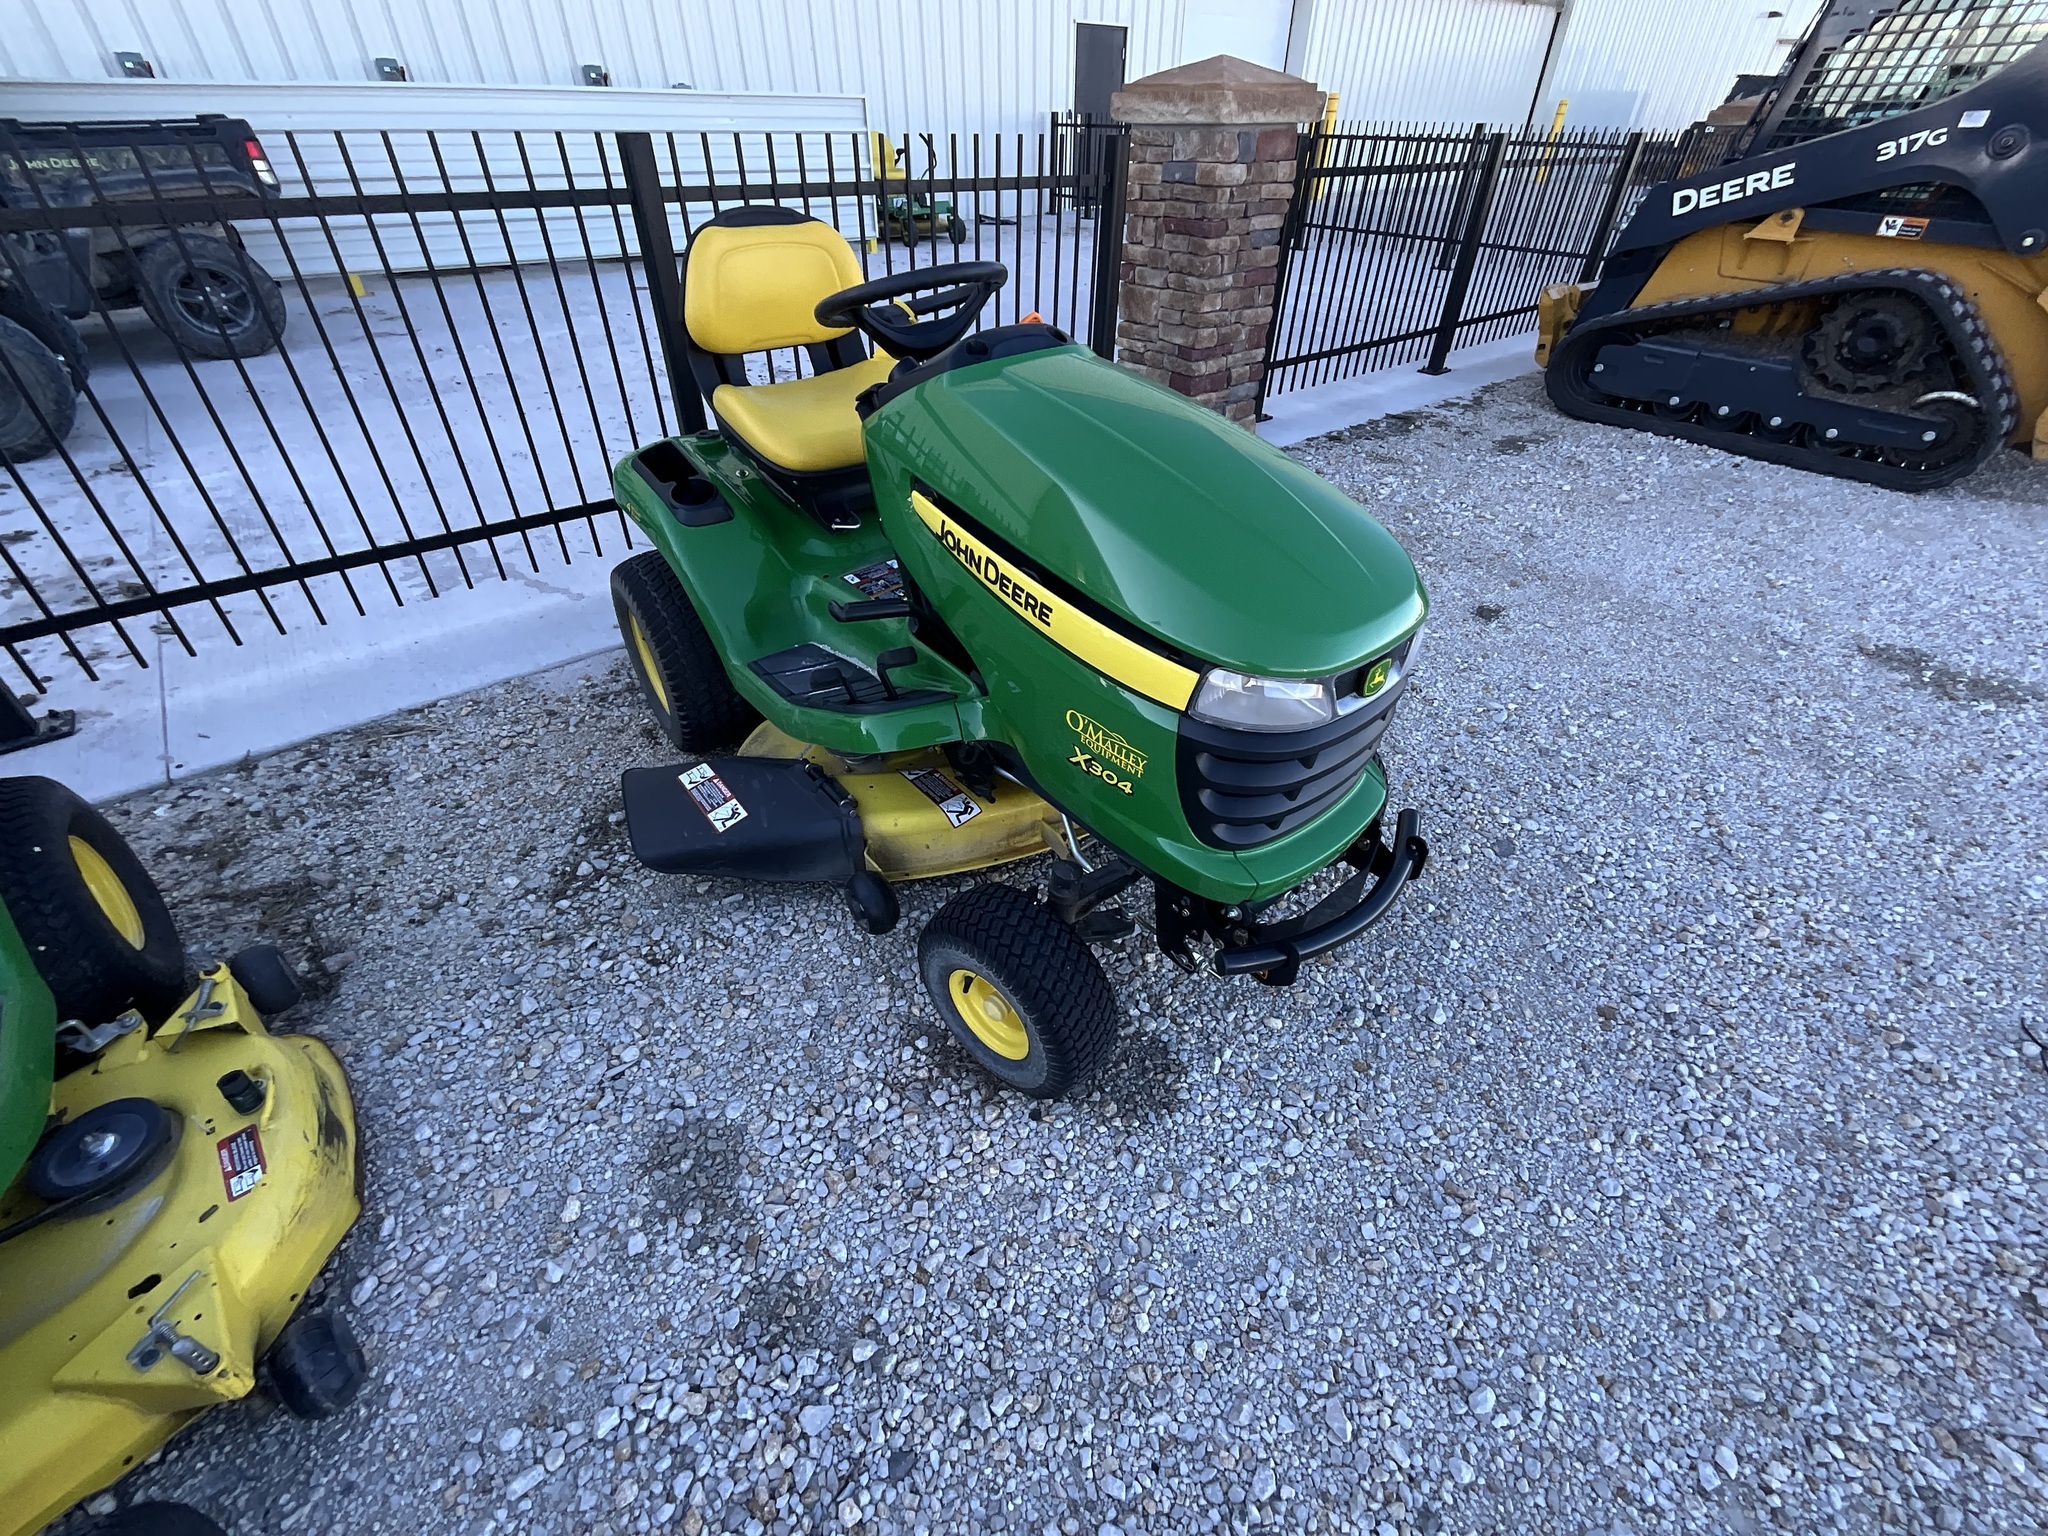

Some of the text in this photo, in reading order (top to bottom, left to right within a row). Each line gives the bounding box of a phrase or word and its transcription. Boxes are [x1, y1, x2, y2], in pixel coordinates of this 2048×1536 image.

[9, 159, 50, 170] JHN
[1876, 127, 1948, 162] 317G
[1672, 162, 1796, 217] DEERE
[935, 519, 1053, 628] JOHN DEERE
[1066, 709, 1148, 772] O'MALLEY
[1081, 733, 1144, 778] EQUIPMENT
[1068, 745, 1133, 794] X304
